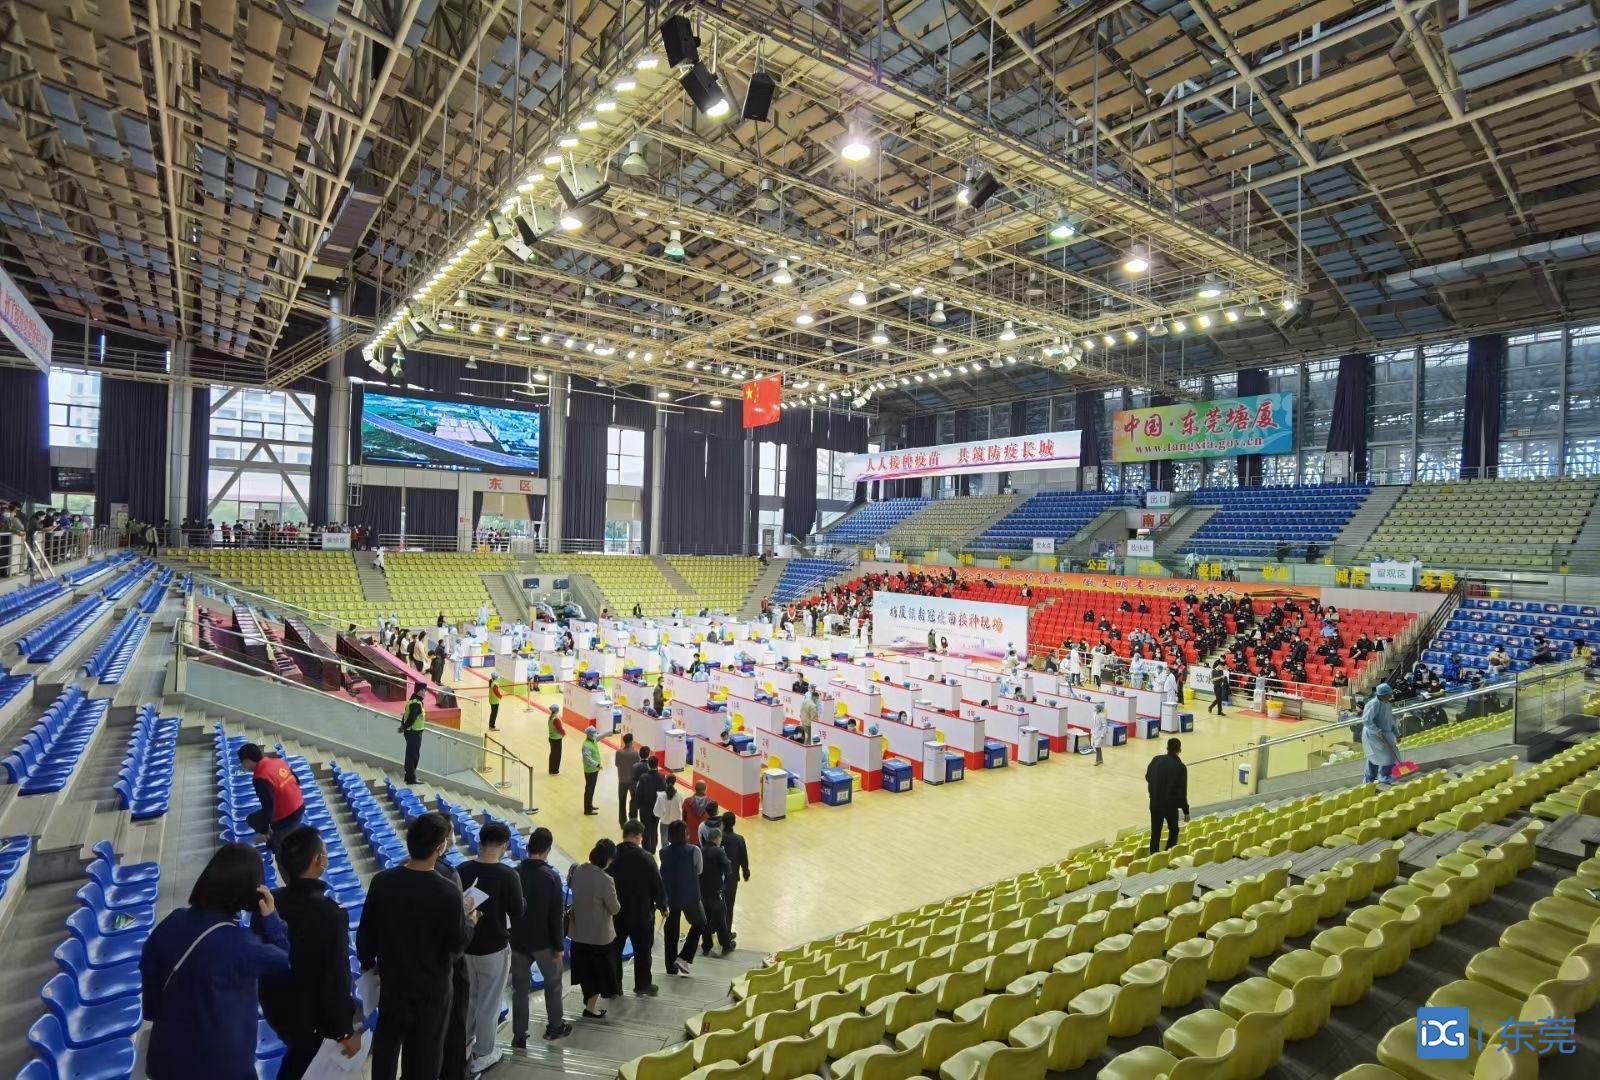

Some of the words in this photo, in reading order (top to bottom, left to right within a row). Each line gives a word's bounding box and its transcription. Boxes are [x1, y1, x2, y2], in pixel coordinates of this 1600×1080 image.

[1123, 399, 1279, 442] 中国·东莞塘厦
[1135, 437, 1265, 455] www.tangxia.gov.cn
[866, 451, 941, 472] 人人接种疫苗
[958, 438, 1056, 464] 共筑防疫长城
[1150, 495, 1168, 504] 出口
[1142, 513, 1173, 528] 南区
[1086, 559, 1107, 571] 公正
[1376, 568, 1408, 579] 留观区
[889, 605, 1004, 633] 塘厦镇新冠疫苗接种现场
